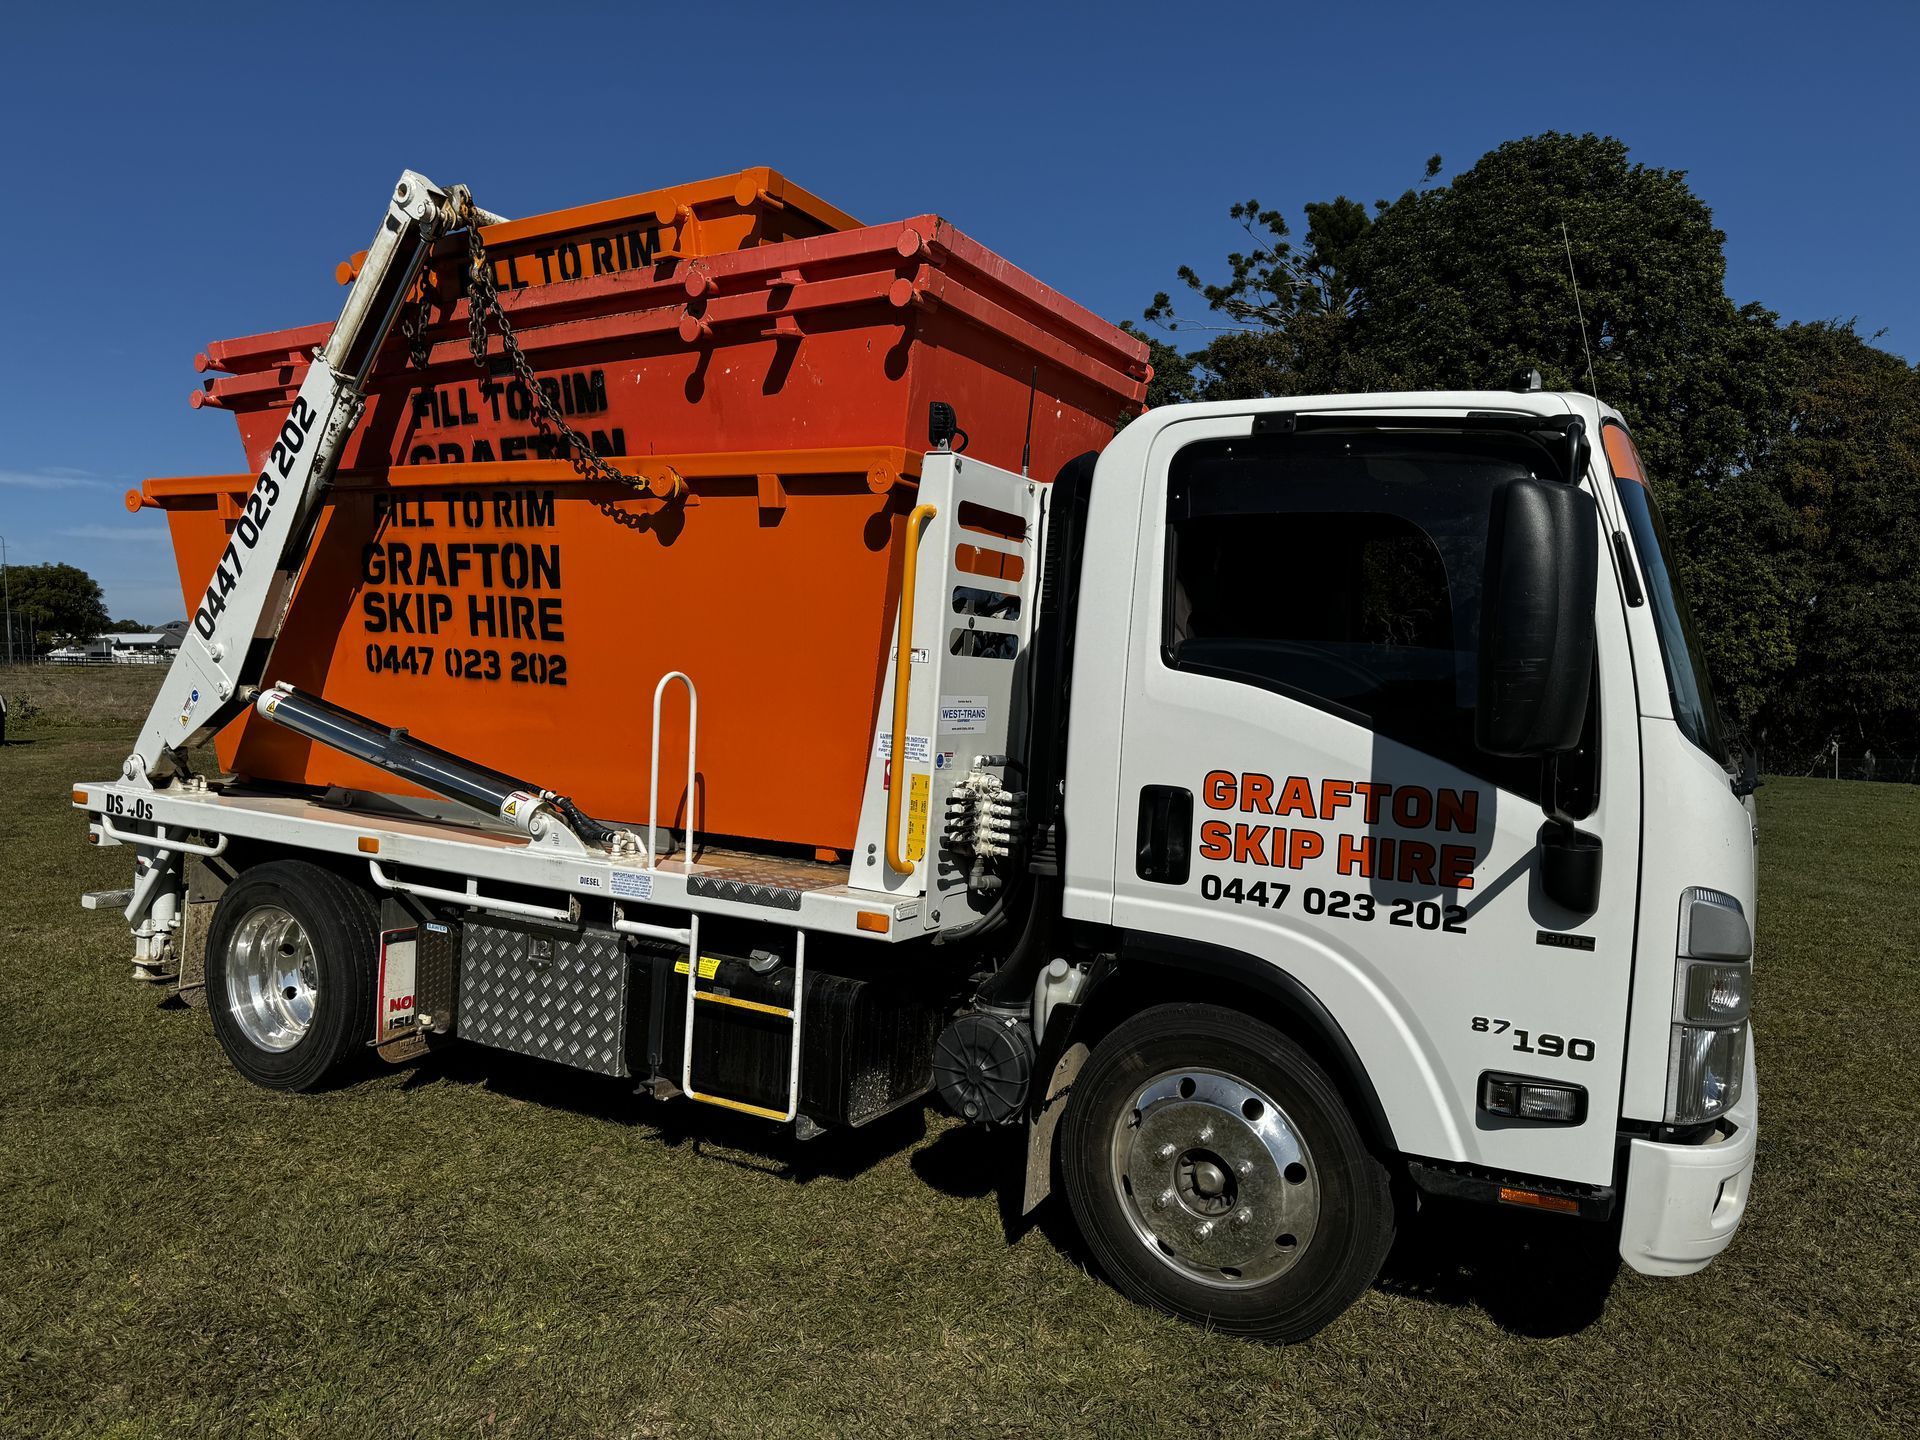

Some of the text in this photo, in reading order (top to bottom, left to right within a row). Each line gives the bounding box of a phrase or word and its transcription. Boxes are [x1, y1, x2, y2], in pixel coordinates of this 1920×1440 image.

[534, 241, 582, 284] TO
[590, 227, 661, 277] RIM
[412, 369, 608, 429] FILL TO RIM
[194, 395, 317, 641] 0447 023 202
[373, 490, 555, 529] FILL TO RIM
[363, 542, 561, 589] GRAFTON
[363, 592, 564, 642] SKIP HIRE
[365, 643, 567, 686] 0447 023 202
[942, 709, 986, 719] WEST-TRANS
[106, 793, 124, 815] DS
[1203, 769, 1479, 834] GRAFTON
[1199, 820, 1476, 890] SKIP HIRE
[580, 876, 600, 887] DIESEL
[1201, 874, 1468, 934] 0447 023 202
[1513, 1029, 1596, 1062] 190
